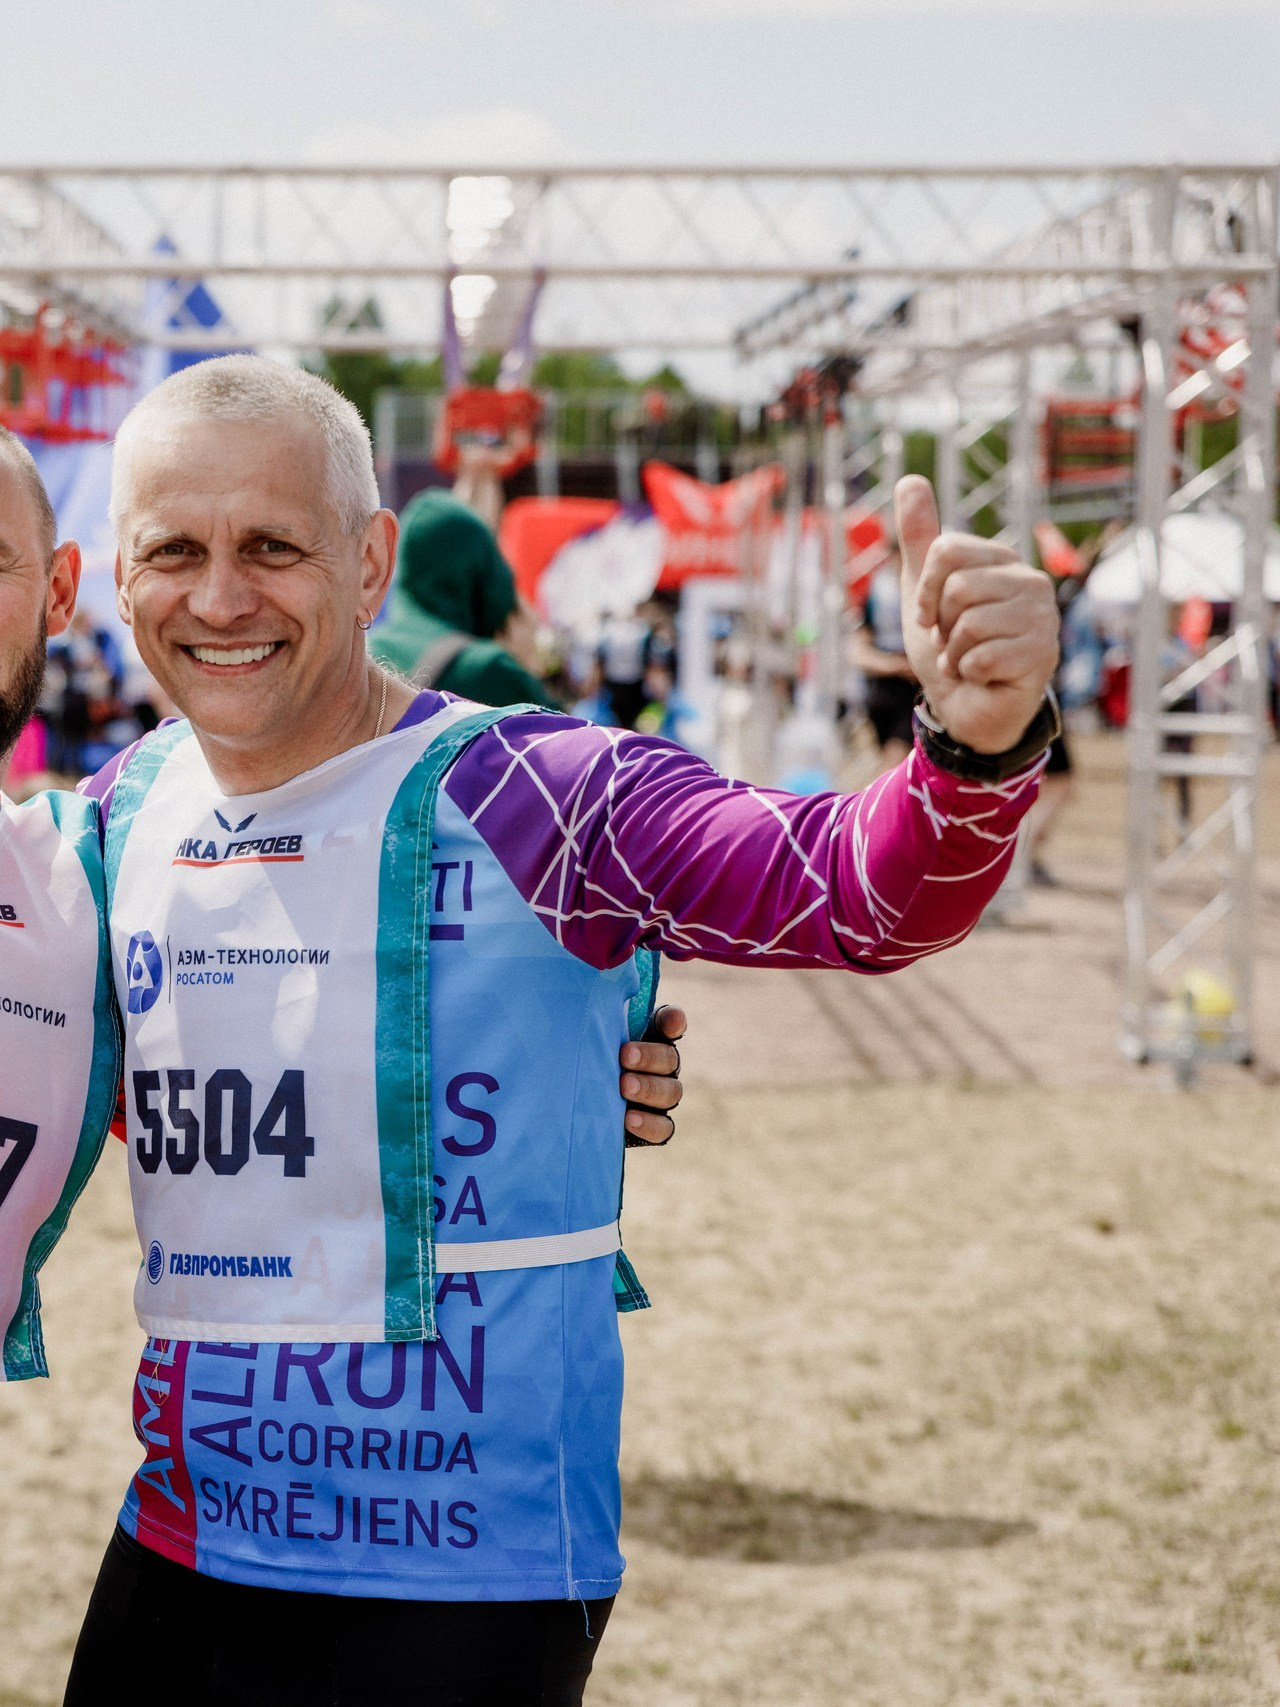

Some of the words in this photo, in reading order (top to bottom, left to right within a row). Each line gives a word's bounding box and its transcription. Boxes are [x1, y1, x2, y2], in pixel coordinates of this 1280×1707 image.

[223, 834, 303, 859] ГЕРОЕВ
[176, 948, 330, 965] АЭМ-ТЕХНОЛОГИИ
[176, 972, 234, 985] РОСАТОМ
[132, 1068, 315, 1178] 5504
[169, 1253, 293, 1278] ГАЗПРОМБАНК
[273, 1325, 485, 1414] RUN
[258, 1419, 479, 1475] CORRIDA
[199, 1477, 480, 1550] SKRĒJIENS
